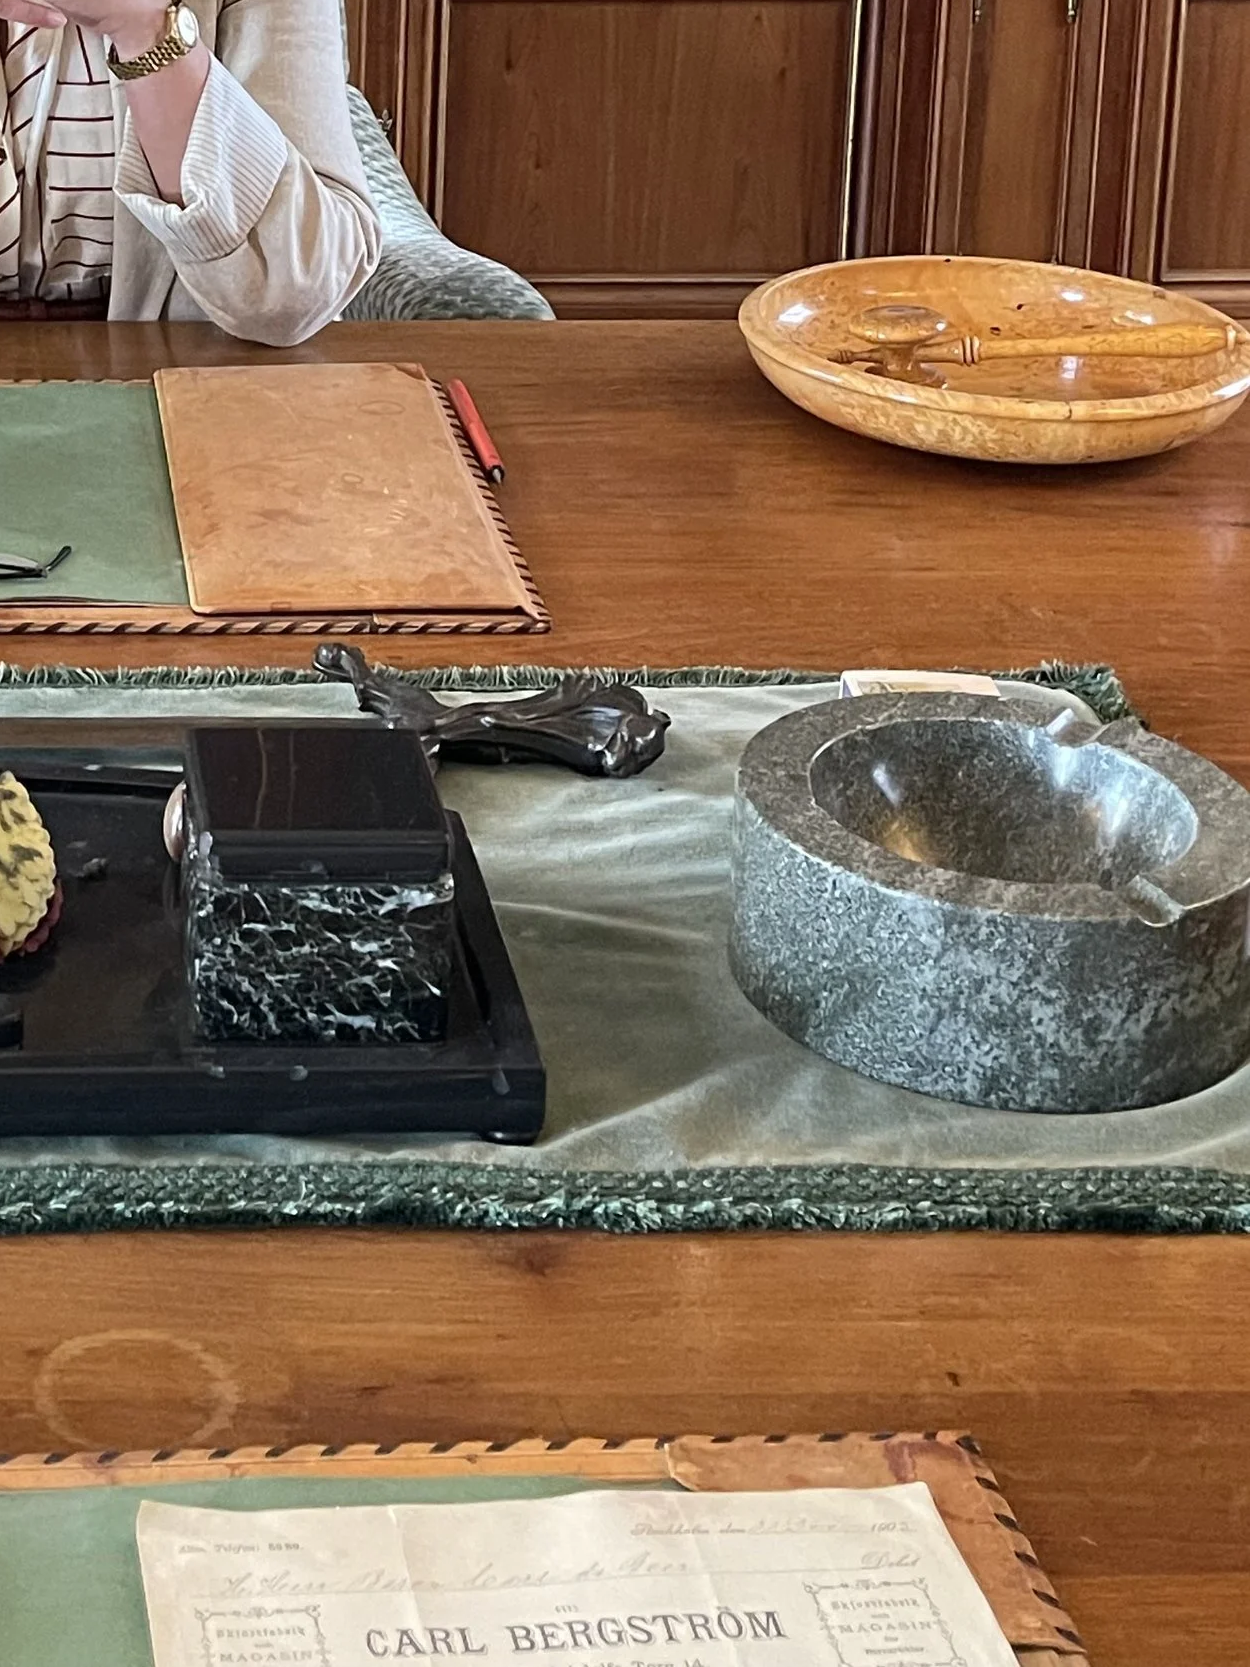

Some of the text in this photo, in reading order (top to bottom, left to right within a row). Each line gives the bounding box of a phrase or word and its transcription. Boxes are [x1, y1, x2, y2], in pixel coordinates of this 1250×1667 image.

[364, 1606, 790, 1658] CARL BERGSTRÖM
[838, 1621, 932, 1634] MAGASIN
[219, 1650, 313, 1663] MAGASIN
